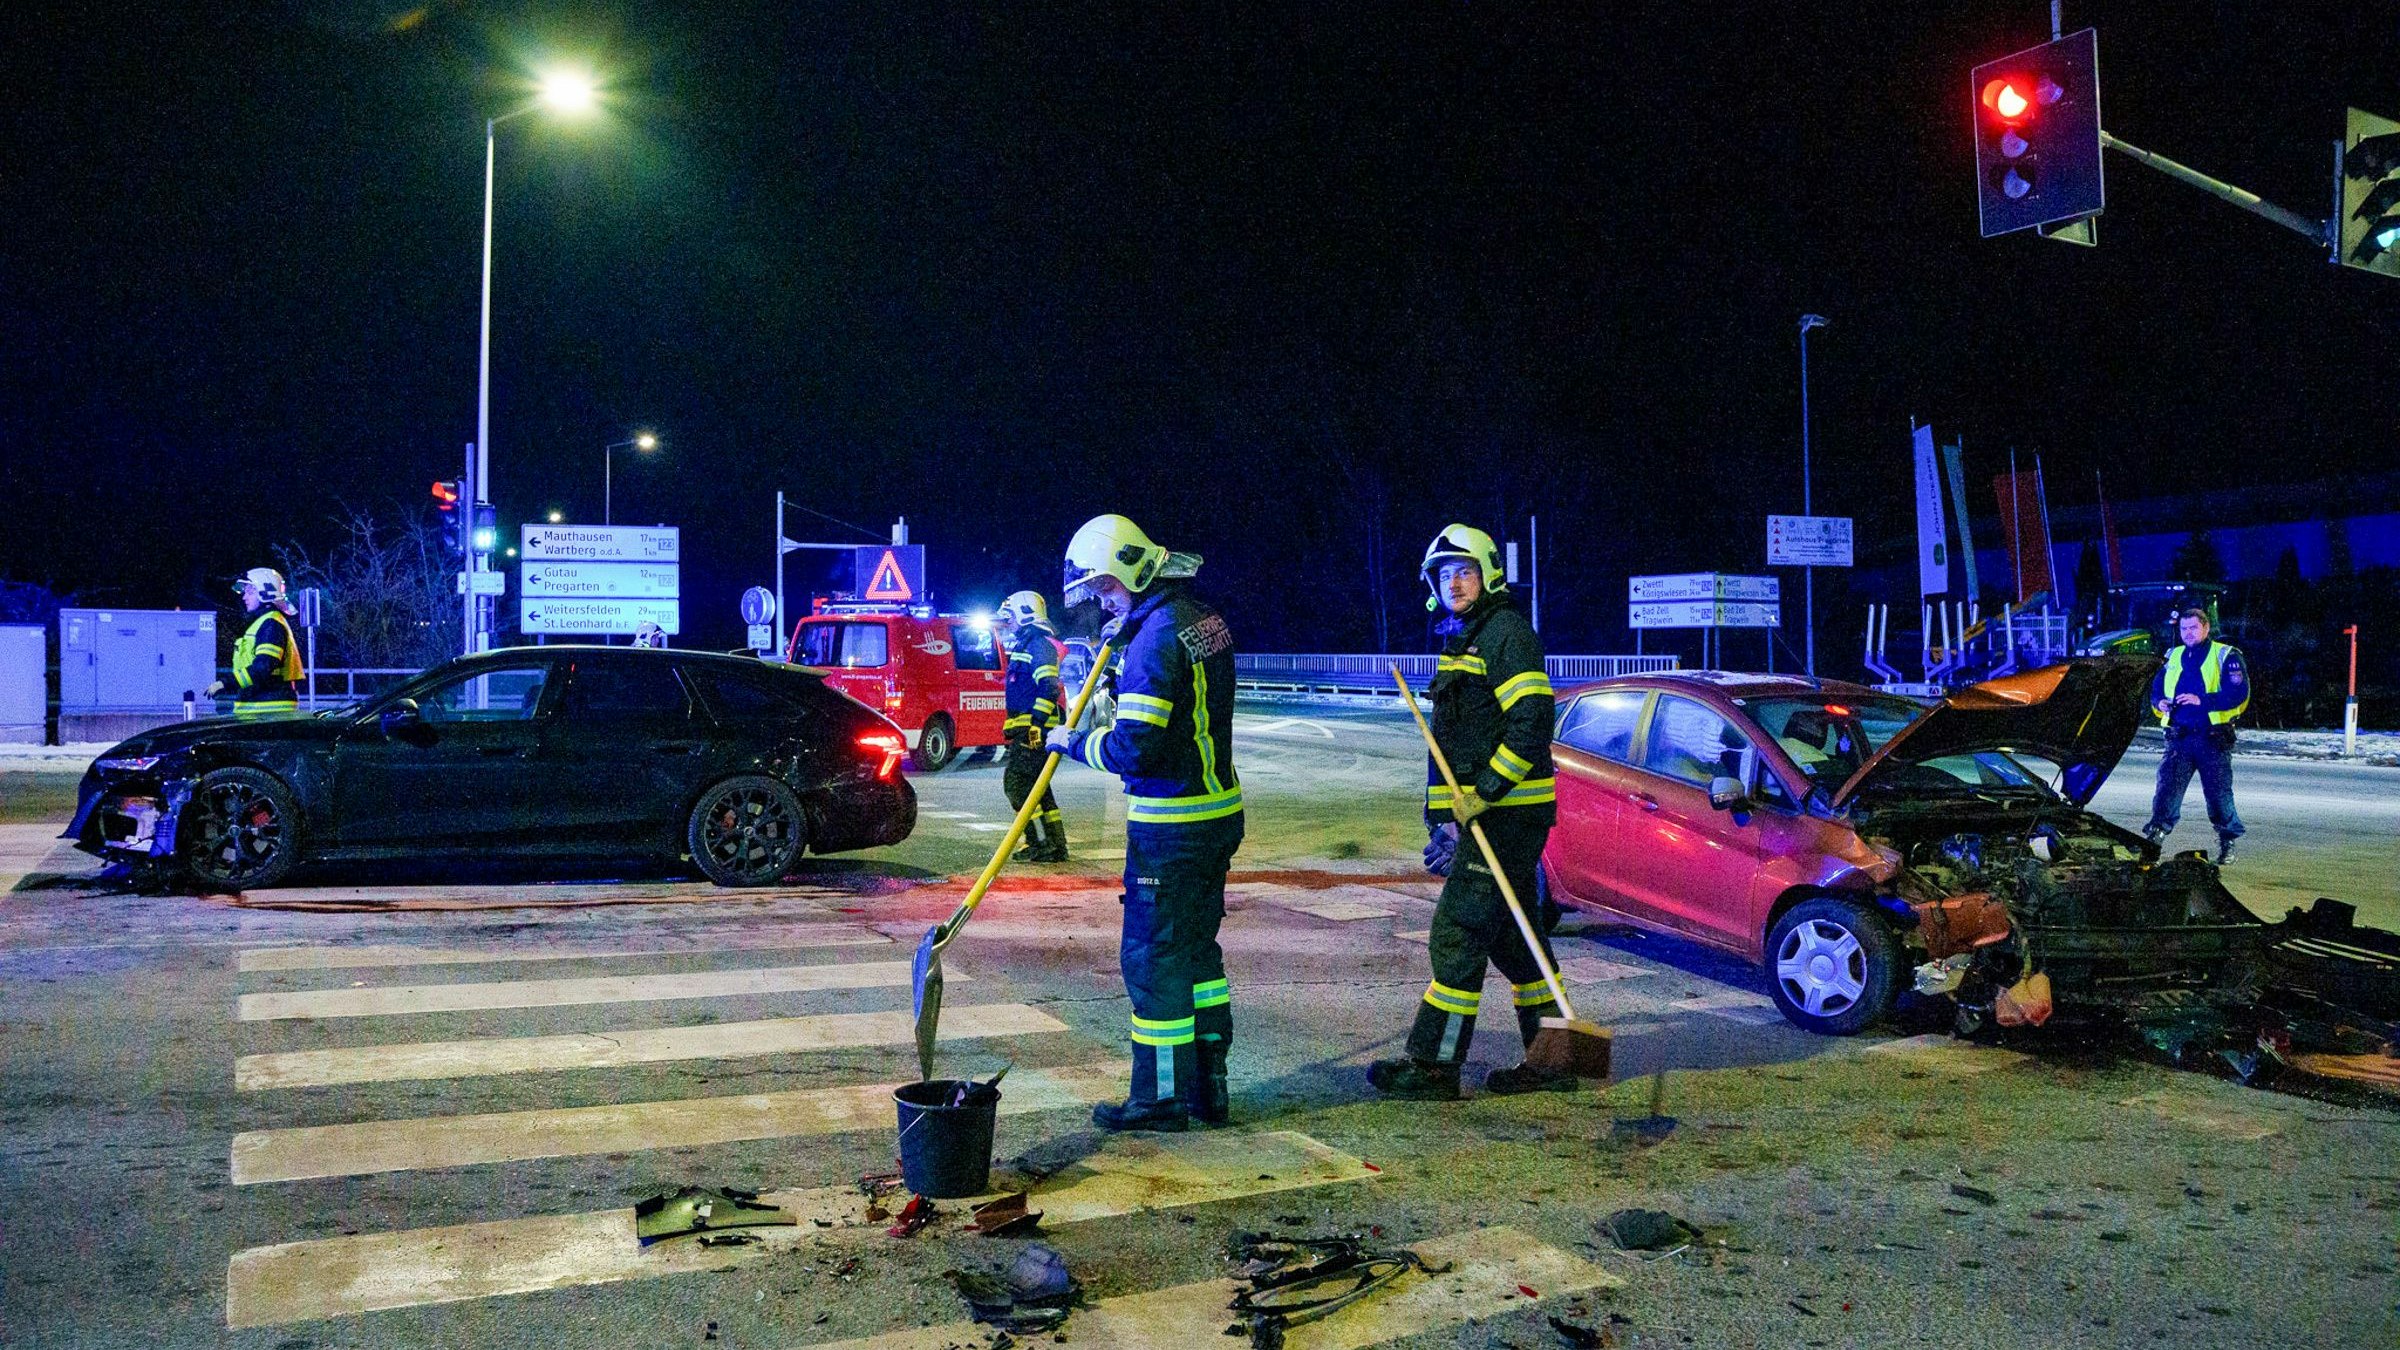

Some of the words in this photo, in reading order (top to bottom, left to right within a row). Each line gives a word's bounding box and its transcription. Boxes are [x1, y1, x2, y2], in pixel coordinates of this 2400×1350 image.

[544, 531, 613, 542] Mauthausen
[640, 534, 648, 542] 17
[544, 545, 596, 557] Wartberg
[644, 547, 648, 556] 1
[544, 567, 578, 577] Gutau
[640, 569, 648, 578] 12
[544, 581, 600, 593] Pregarten
[544, 604, 621, 615] Weitersfelden
[638, 606, 648, 615] 29
